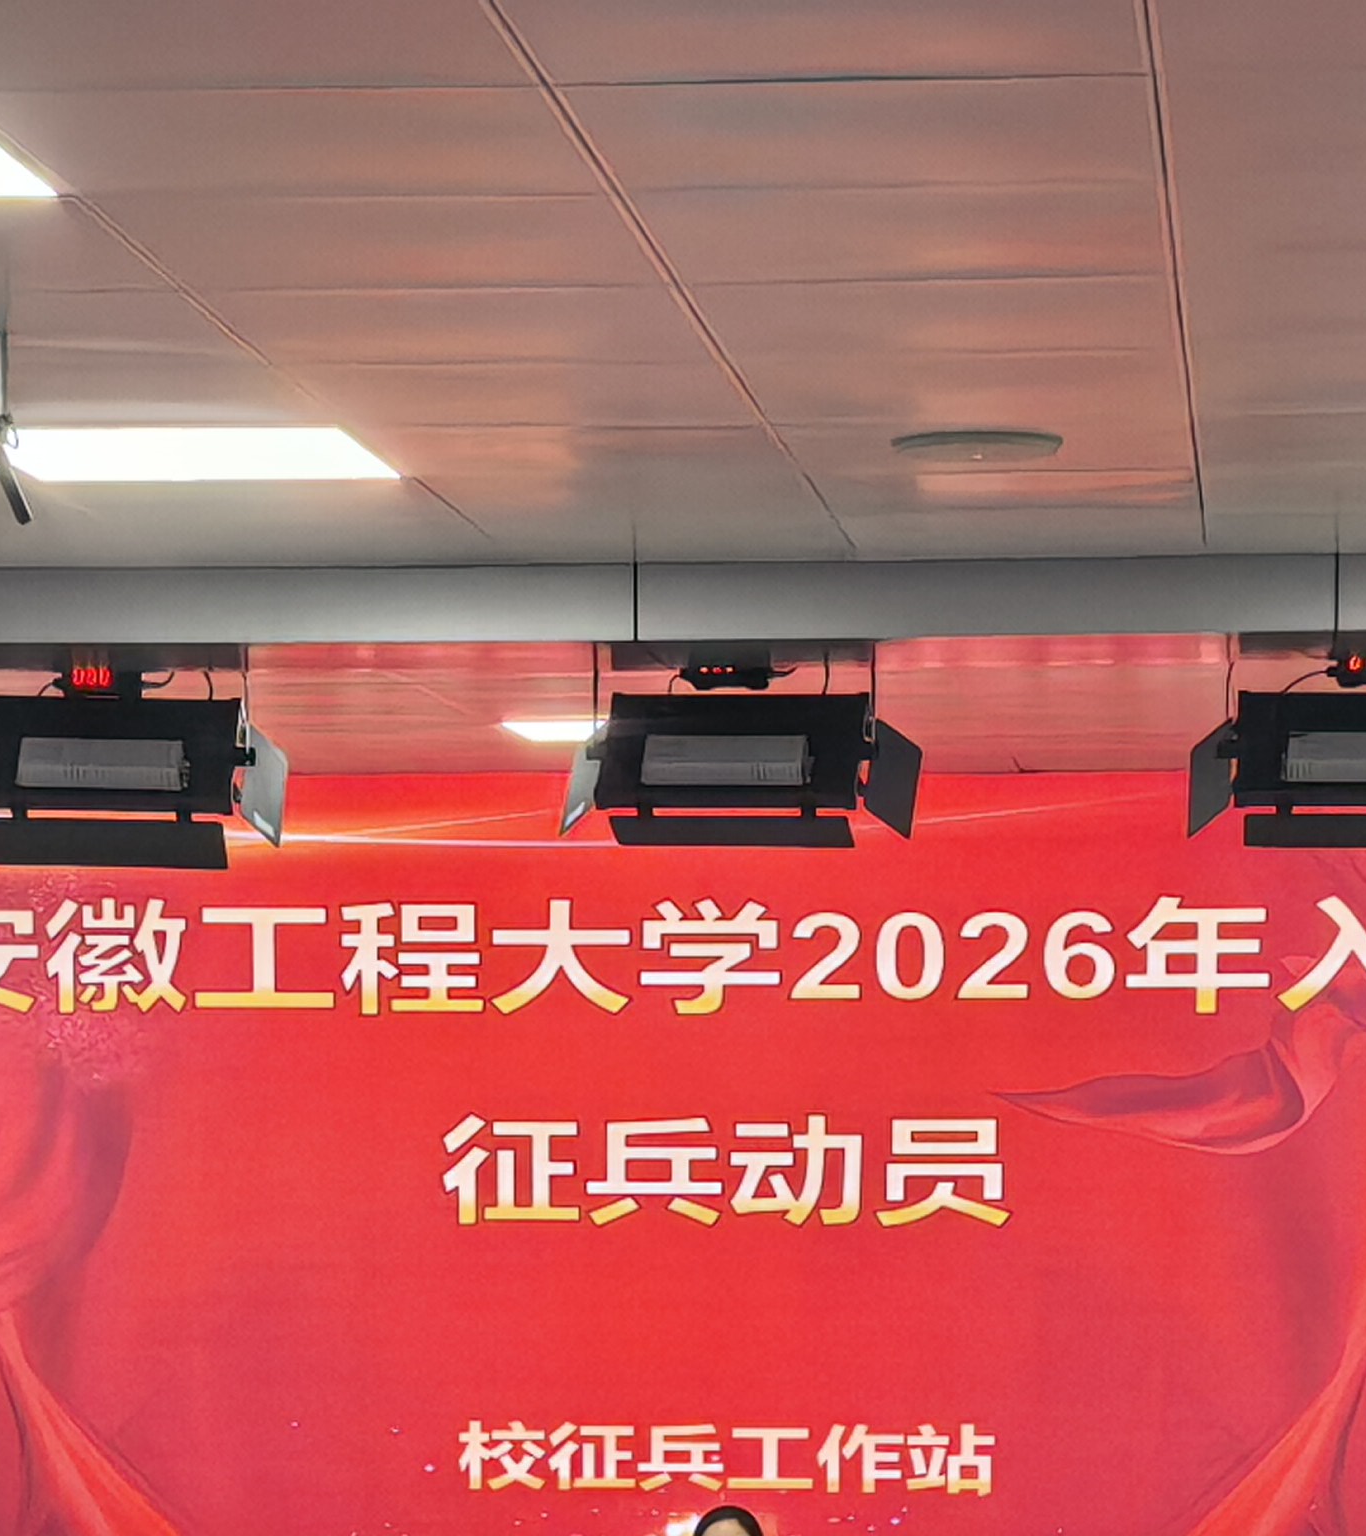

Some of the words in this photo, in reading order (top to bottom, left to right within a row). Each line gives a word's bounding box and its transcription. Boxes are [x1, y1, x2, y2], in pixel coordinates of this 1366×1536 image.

[441, 1114, 1013, 1228] 征兵动员
[457, 1419, 996, 1497] 校征兵工作站
